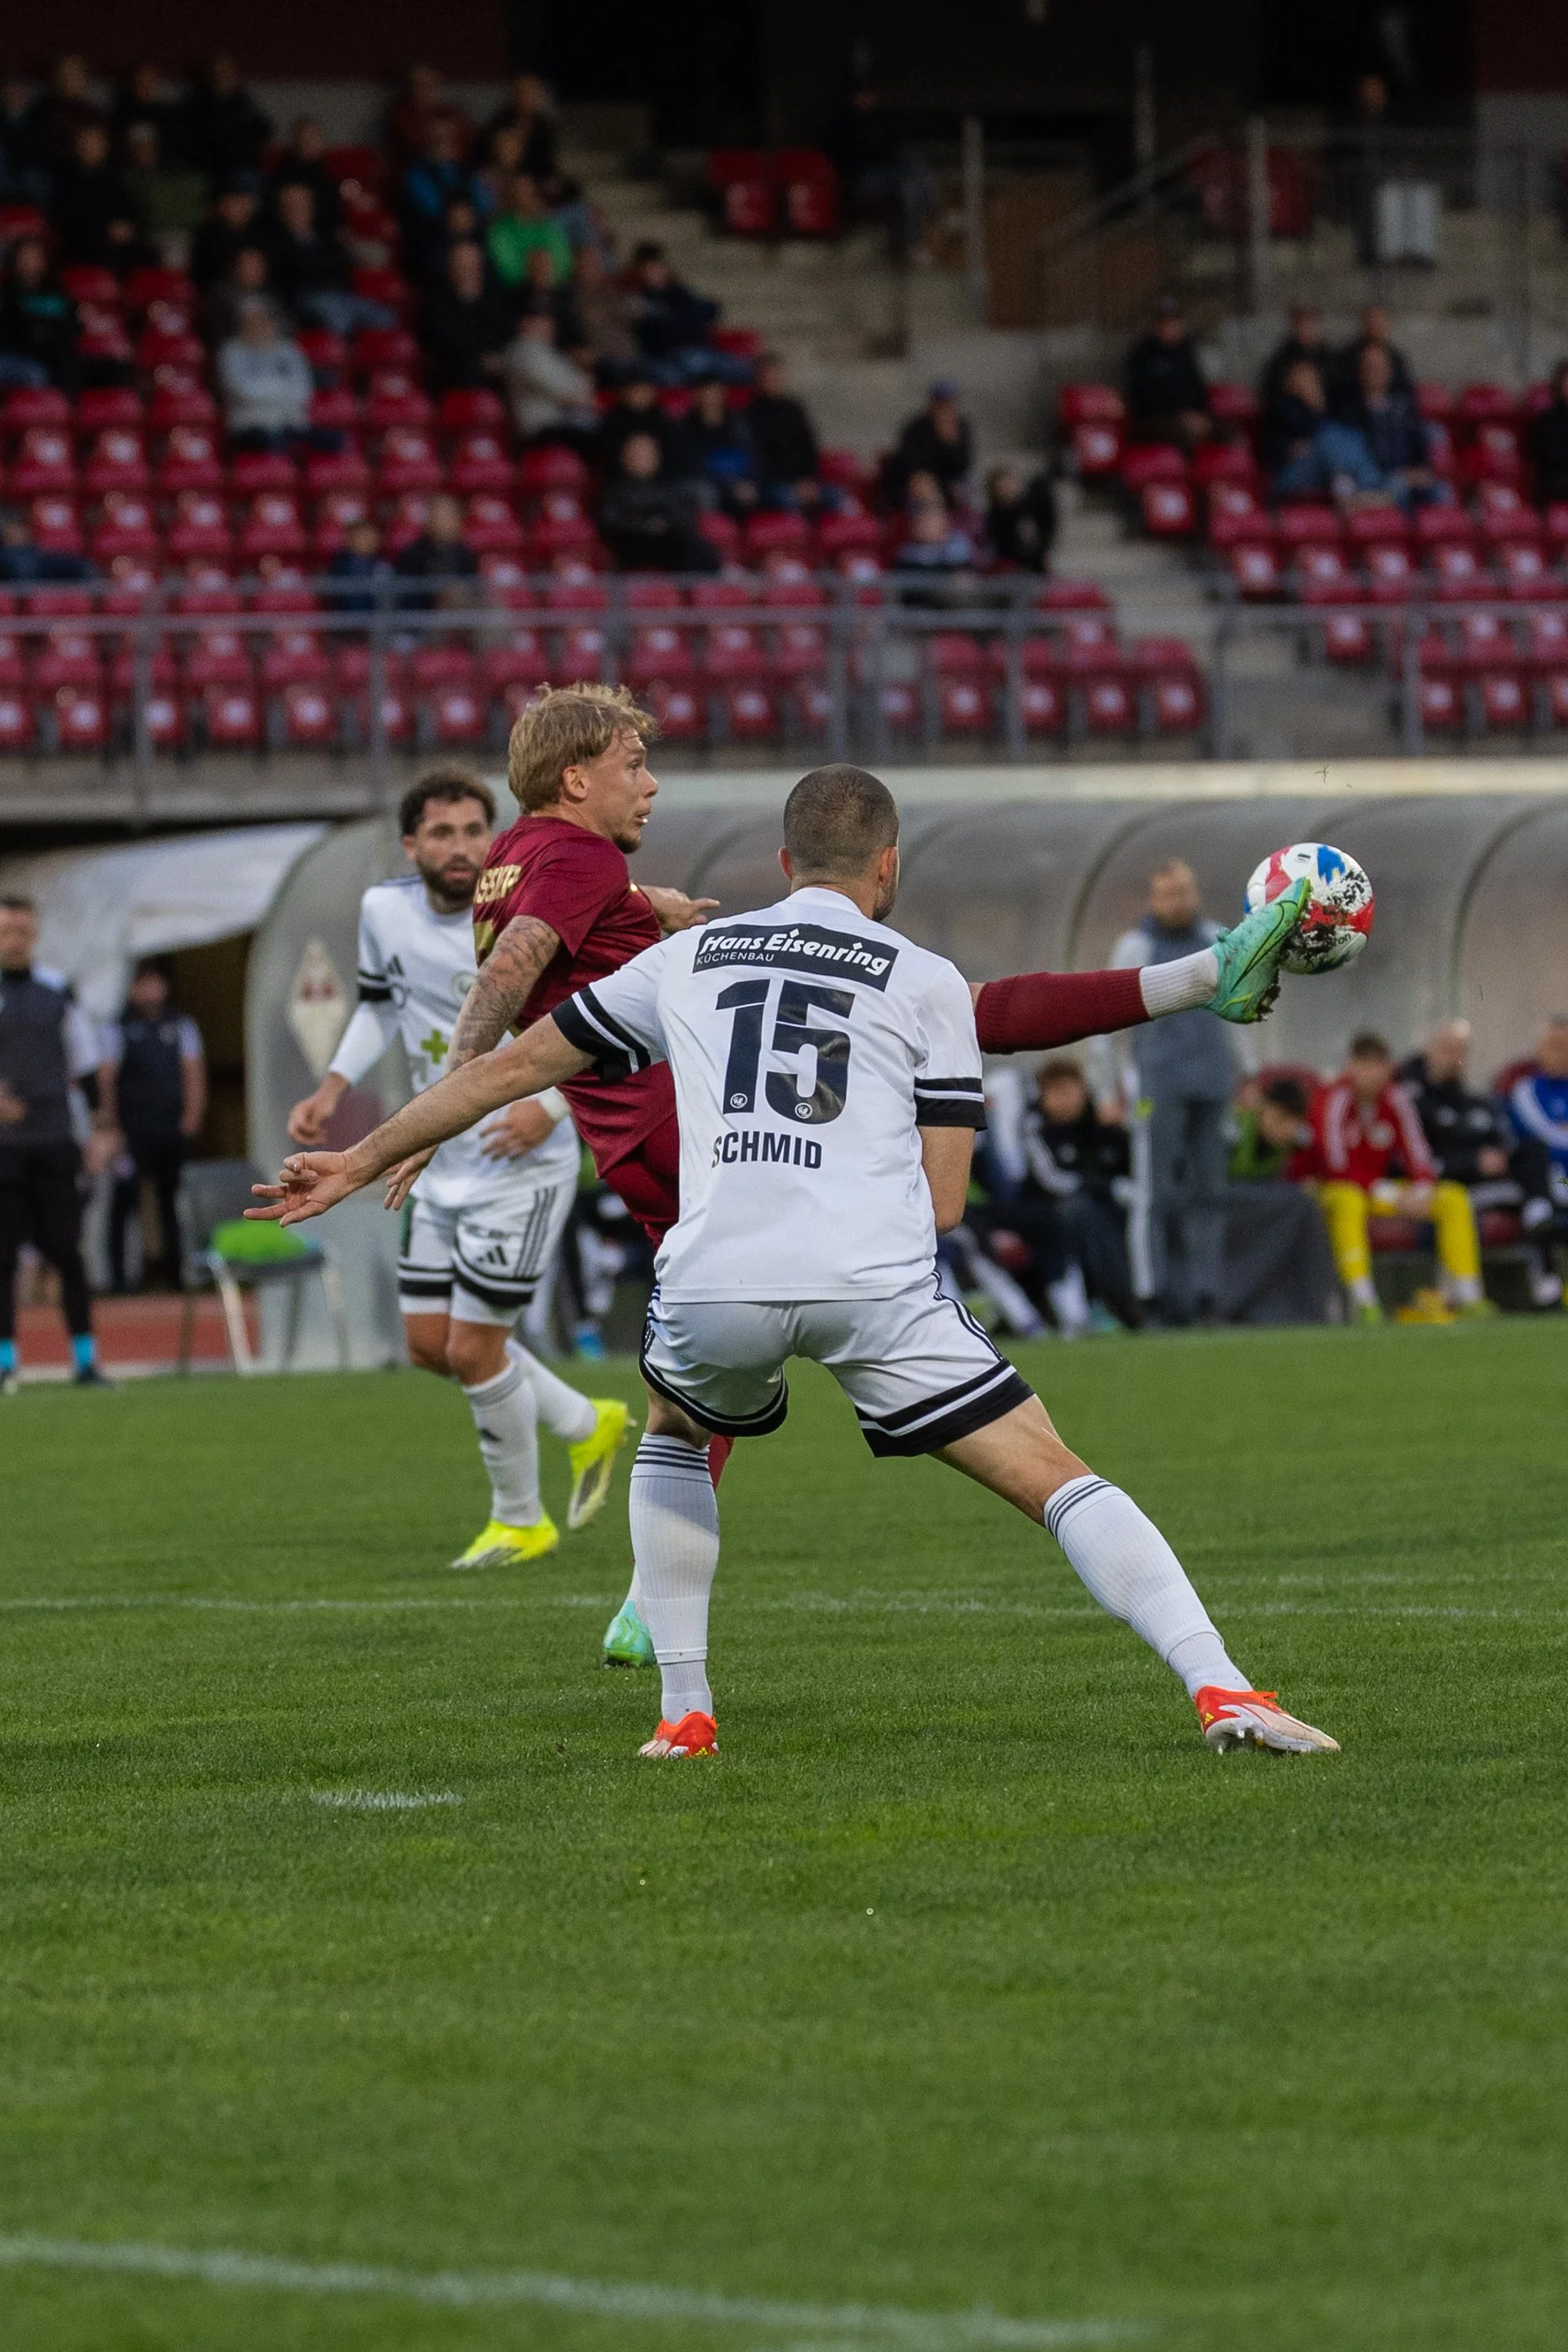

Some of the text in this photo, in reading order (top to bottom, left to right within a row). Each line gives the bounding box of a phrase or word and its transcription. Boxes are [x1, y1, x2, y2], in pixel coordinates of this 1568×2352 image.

[696, 951, 775, 966] KÜCHENBAU
[699, 928, 891, 976] Hans Eisenring
[715, 978, 856, 1125] 15
[711, 1131, 822, 1170] SCHMID
